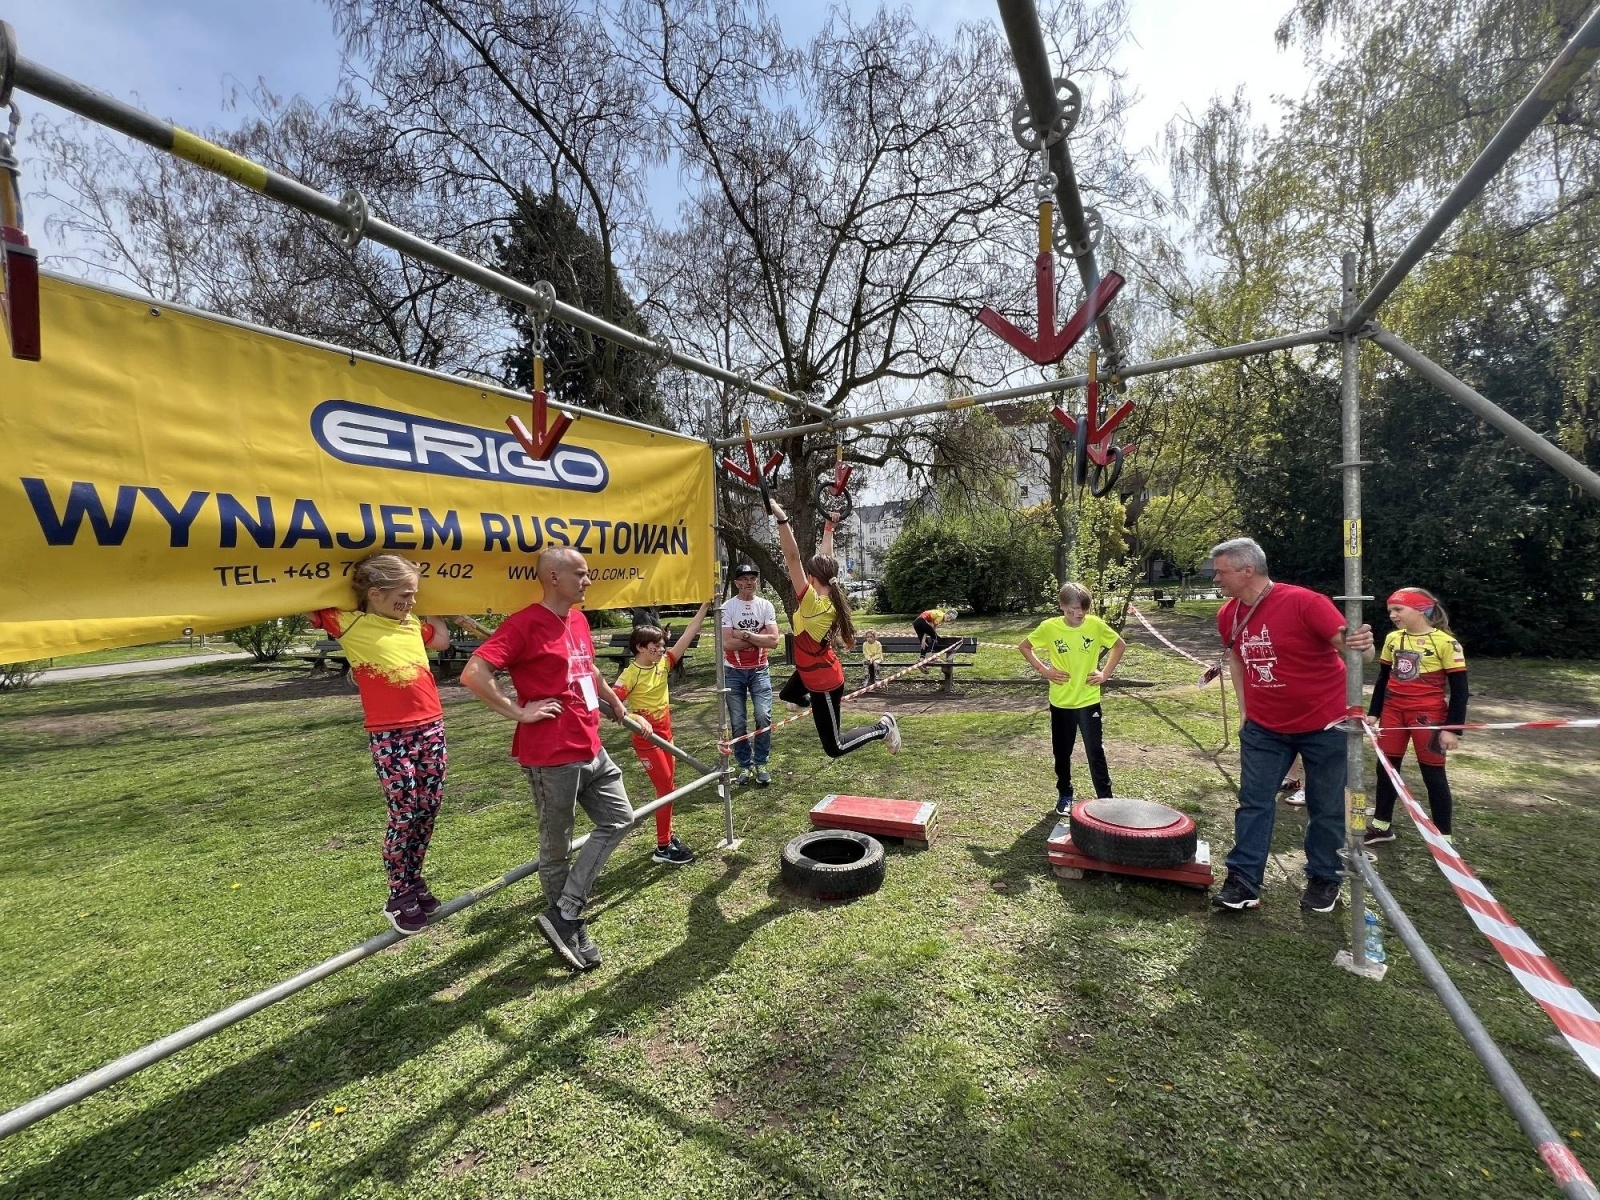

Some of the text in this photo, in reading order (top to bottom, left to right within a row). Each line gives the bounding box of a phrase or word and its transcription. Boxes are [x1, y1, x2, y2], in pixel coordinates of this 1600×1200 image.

[323, 409, 604, 486] ERIGO
[20, 477, 689, 556] WYNAJEM RUSZTOWAŃ
[213, 565, 277, 587] TEL.
[283, 562, 331, 579] +48
[436, 562, 474, 579] 402
